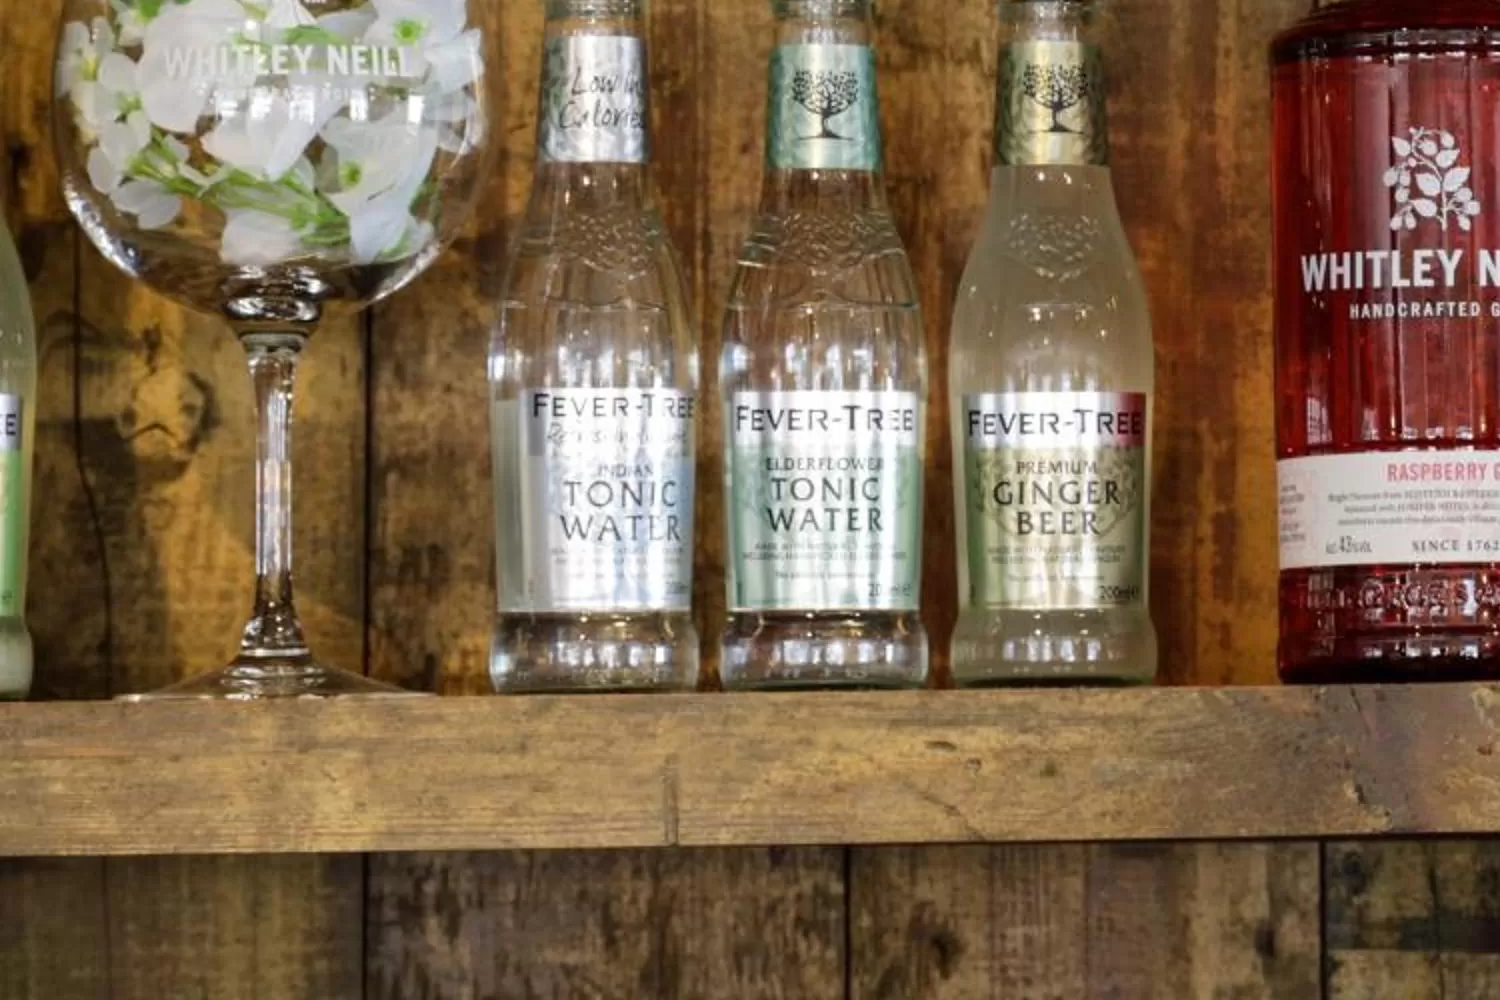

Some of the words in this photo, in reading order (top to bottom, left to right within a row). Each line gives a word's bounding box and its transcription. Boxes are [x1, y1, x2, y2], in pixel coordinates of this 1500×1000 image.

[163, 43, 315, 77] WHITLEY
[327, 43, 411, 77] NEILL
[1301, 249, 1463, 293] WHITLEY
[1349, 301, 1481, 319] HANDCRAFTED
[532, 392, 695, 419] FEVER-TREE
[736, 404, 914, 433] FEVER-TREE
[968, 408, 1142, 438] FEVER-TREE
[1015, 459, 1098, 475] PREMIUM
[1386, 462, 1488, 483] RASPBERRY
[564, 480, 677, 507] TONIC
[770, 477, 881, 502] TONIC
[992, 479, 1121, 506] GINGER
[560, 514, 681, 542] WATER
[766, 507, 884, 533] WATER
[1016, 510, 1101, 536] BEER
[1411, 538, 1460, 552] SINCE
[1466, 538, 1500, 552] 1762
